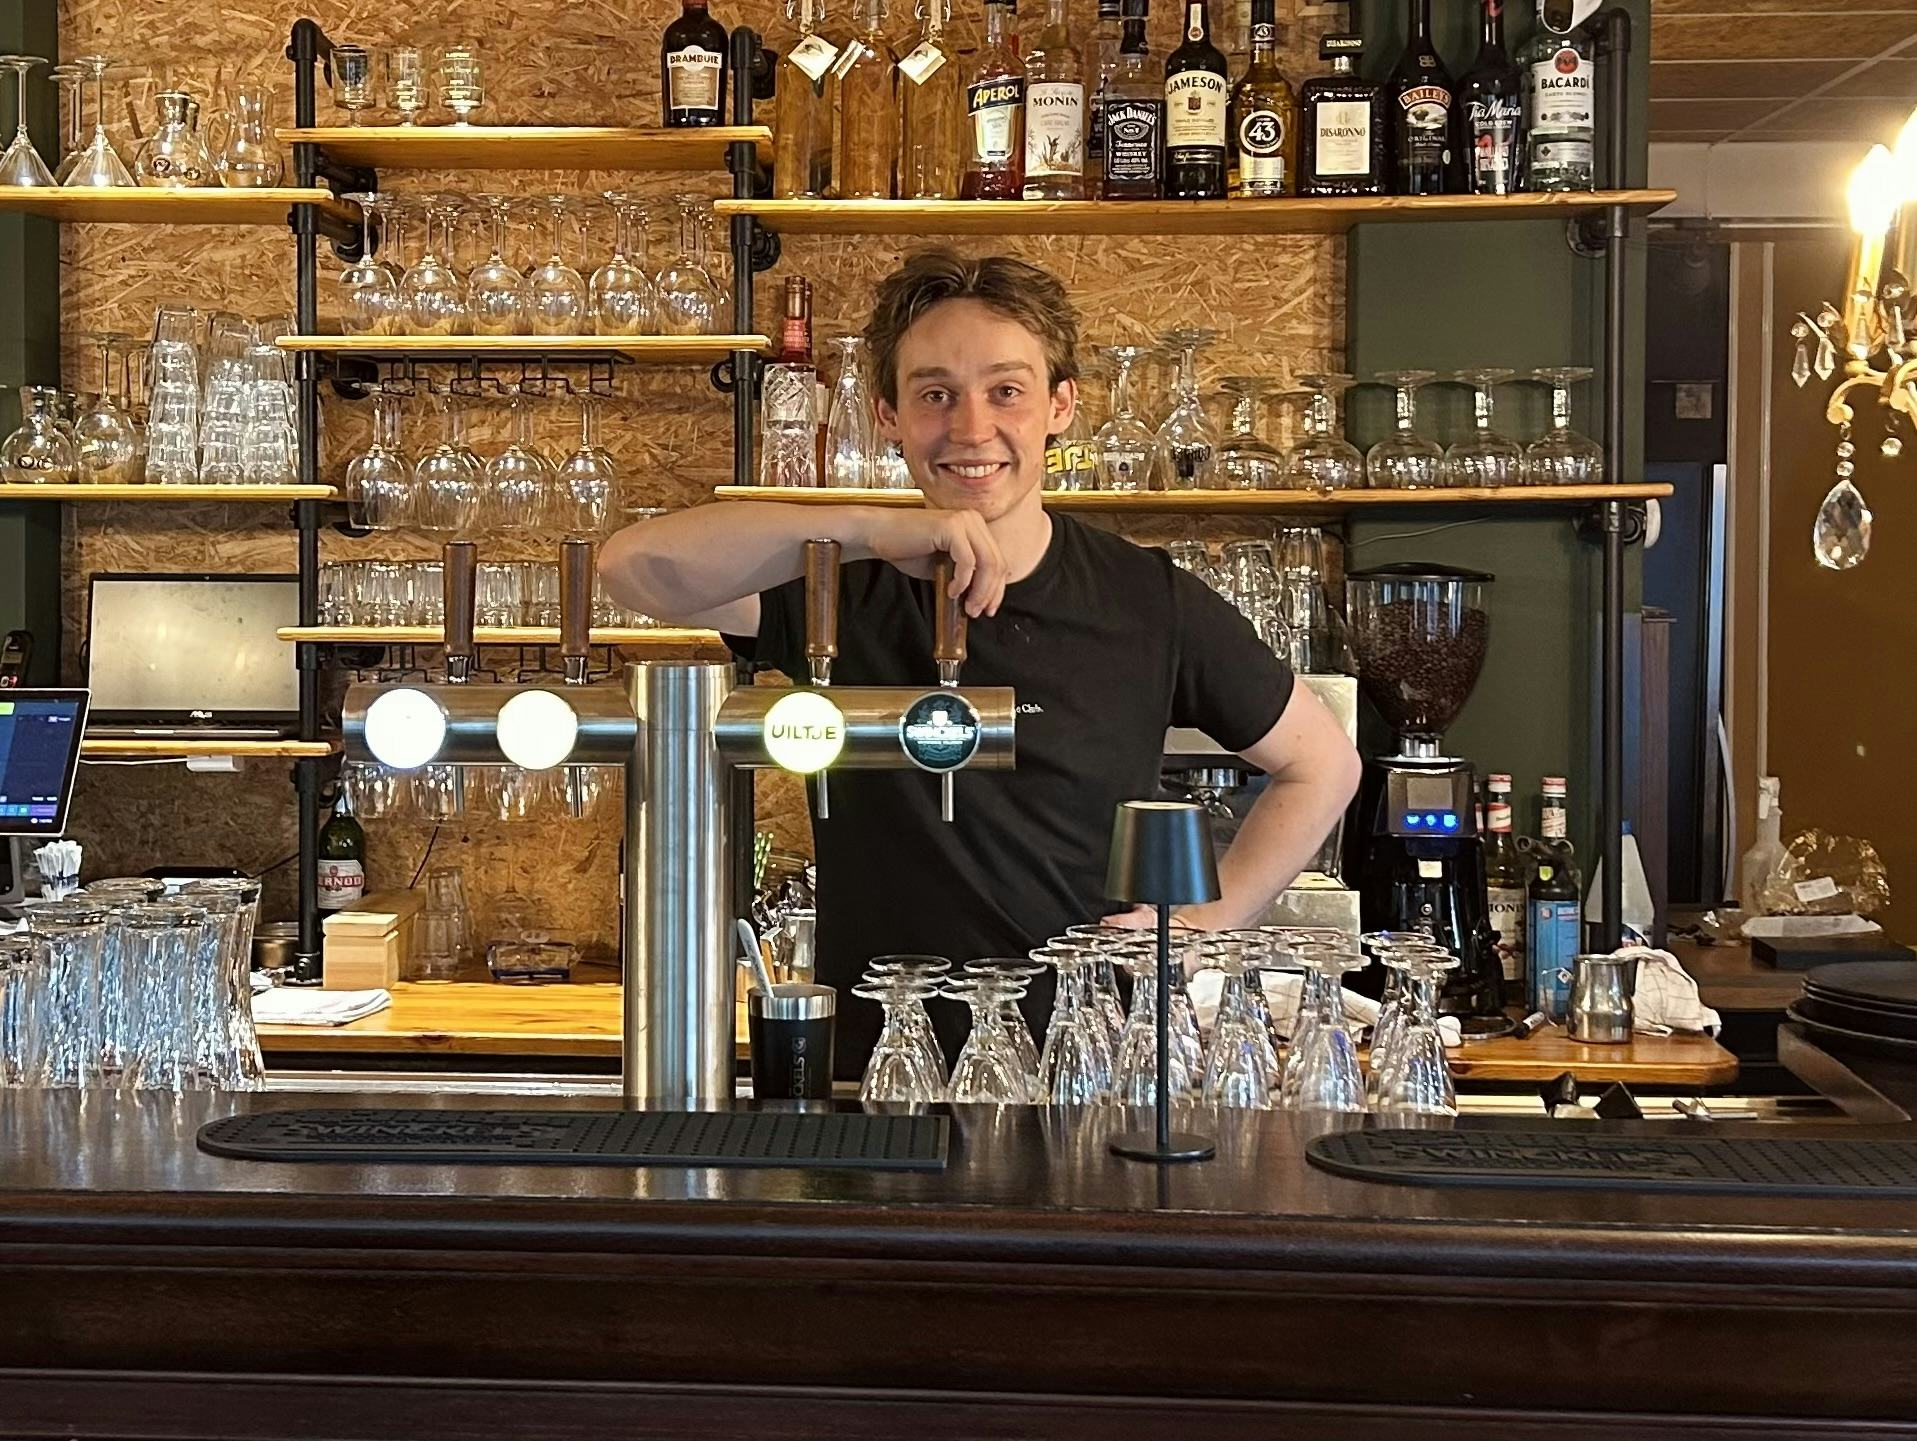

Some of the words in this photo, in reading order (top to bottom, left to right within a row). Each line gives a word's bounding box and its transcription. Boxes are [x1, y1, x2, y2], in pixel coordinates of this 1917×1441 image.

[669, 54, 719, 64] DRAMBUIE
[1168, 77, 1223, 95] JAMESON
[973, 85, 1020, 109] APEROL
[1033, 96, 1079, 107] MONIN
[1402, 88, 1449, 104] BAILEYS
[1466, 101, 1488, 121] Tia
[1484, 98, 1522, 120] Maria
[1107, 110, 1127, 126] JACK
[1248, 122, 1276, 142] 43
[1320, 127, 1366, 138] DISARONNO
[1045, 444, 1095, 473] TJE
[771, 725, 837, 740] UILTJE
